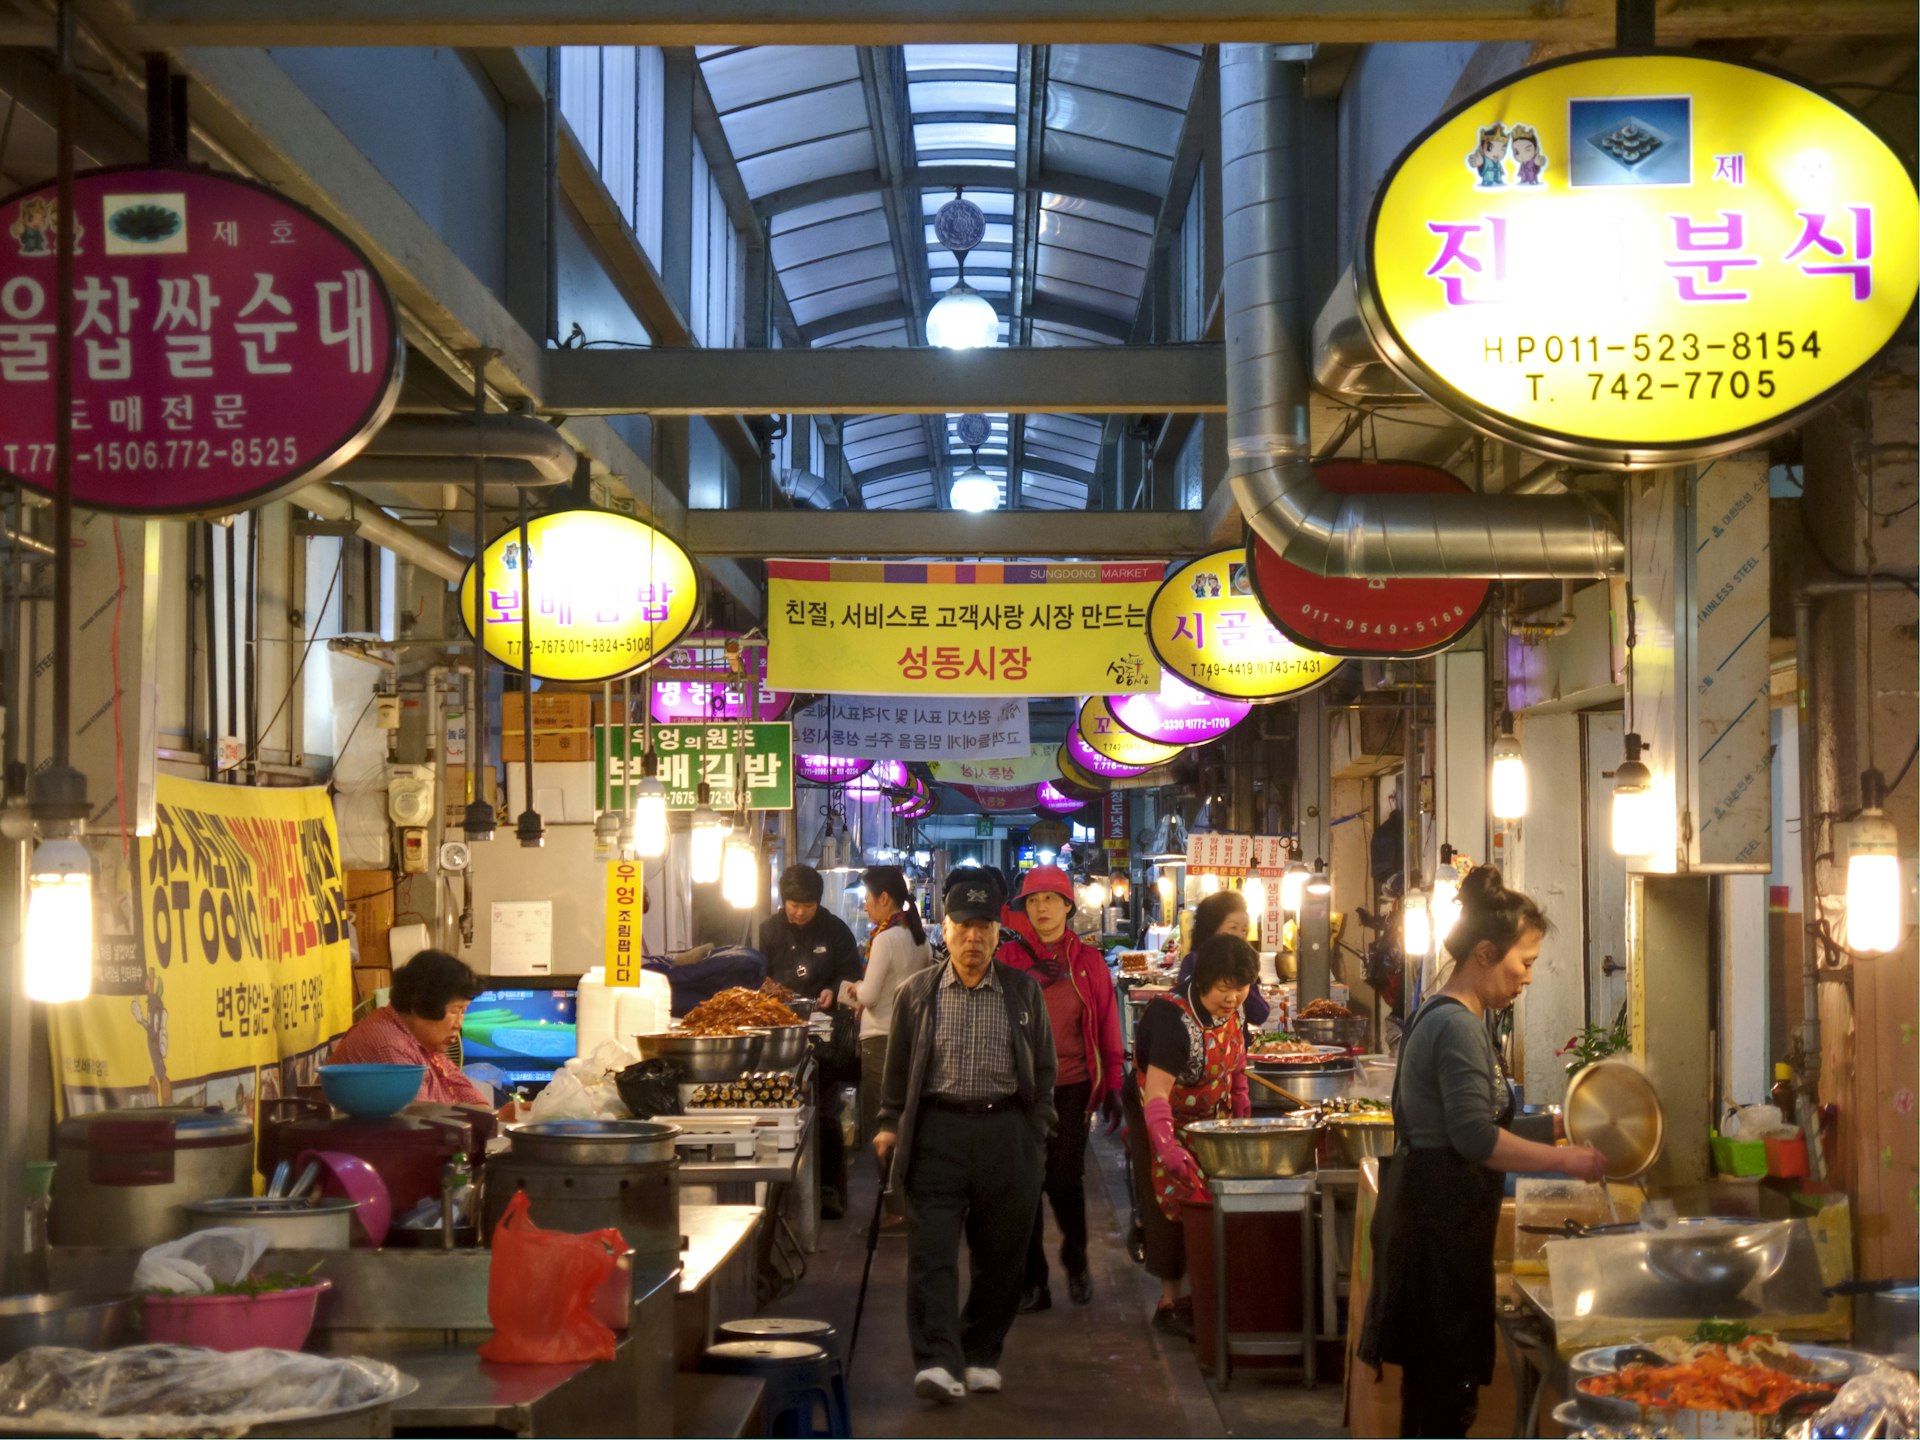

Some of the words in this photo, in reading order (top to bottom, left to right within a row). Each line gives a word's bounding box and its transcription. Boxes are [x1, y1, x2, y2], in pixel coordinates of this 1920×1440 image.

[1714, 154, 1744, 185] 제
[212, 220, 238, 246] 제
[270, 219, 296, 245] 호
[1427, 207, 1872, 306] 진분식
[1588, 369, 1777, 401] 742-7705
[4, 437, 299, 473] T.77-1506.772-8525
[1030, 568, 1097, 580] SUNGDONG
[1101, 567, 1149, 579] MARKET
[1697, 583, 1735, 629] TAINLESS
[1733, 556, 1760, 585] STEEL
[785, 599, 834, 629] 친절,
[841, 602, 930, 630] 서비스로
[935, 604, 1025, 631] 고객사랑
[1030, 603, 1074, 630] 시장
[1081, 602, 1147, 629] 만드는
[1301, 603, 1464, 635] 011-9549-5768
[507, 637, 652, 656] T.72-7675.011-9824-5108
[897, 645, 1032, 682] 성동시장
[616, 864, 636, 906] 우엉
[616, 910, 632, 983] 조림팝니다
